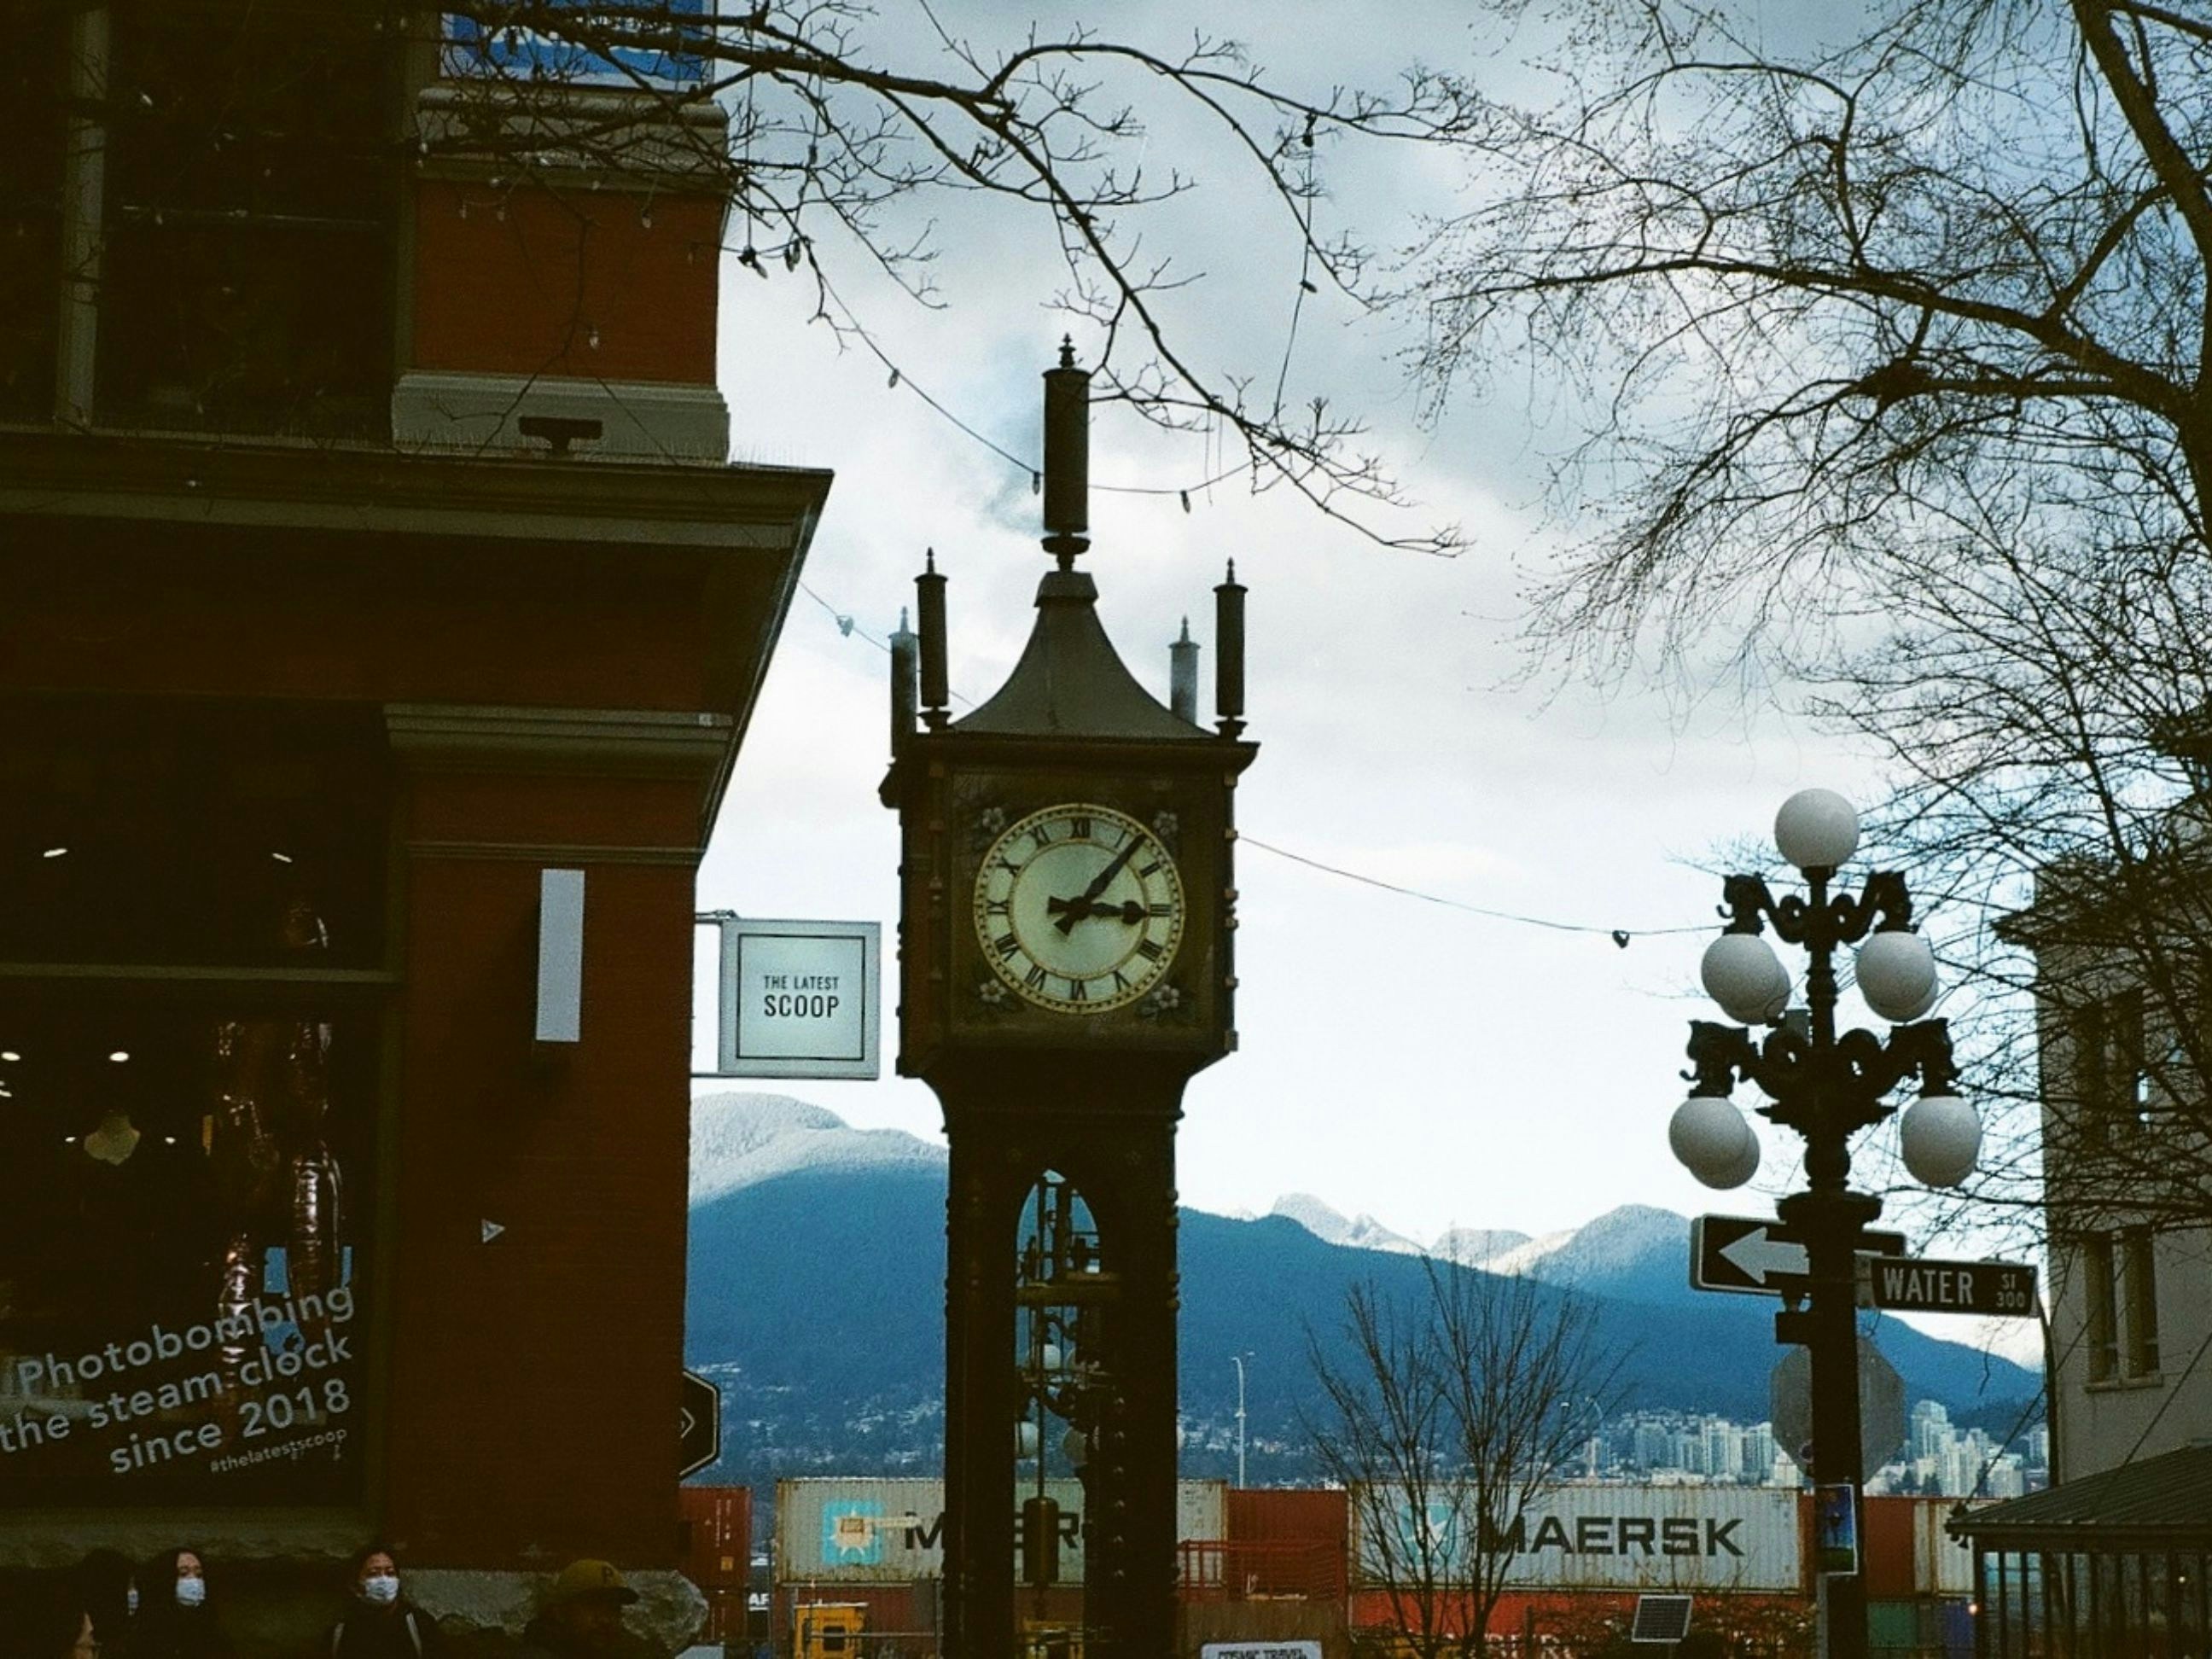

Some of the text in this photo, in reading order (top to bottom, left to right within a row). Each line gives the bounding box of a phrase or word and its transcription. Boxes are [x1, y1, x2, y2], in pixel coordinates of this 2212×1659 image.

[764, 975, 840, 991] THE LATEST
[764, 994, 840, 1018] SCOOP
[1883, 1266, 1974, 1306] WATER
[1995, 1291, 2026, 1308] 300
[2000, 1272, 2017, 1290] ST
[17, 1286, 355, 1395] Photobombing
[0, 1328, 353, 1452] the steam clock
[109, 1377, 351, 1473] since 2018
[210, 1429, 348, 1473] #thelatestscoop
